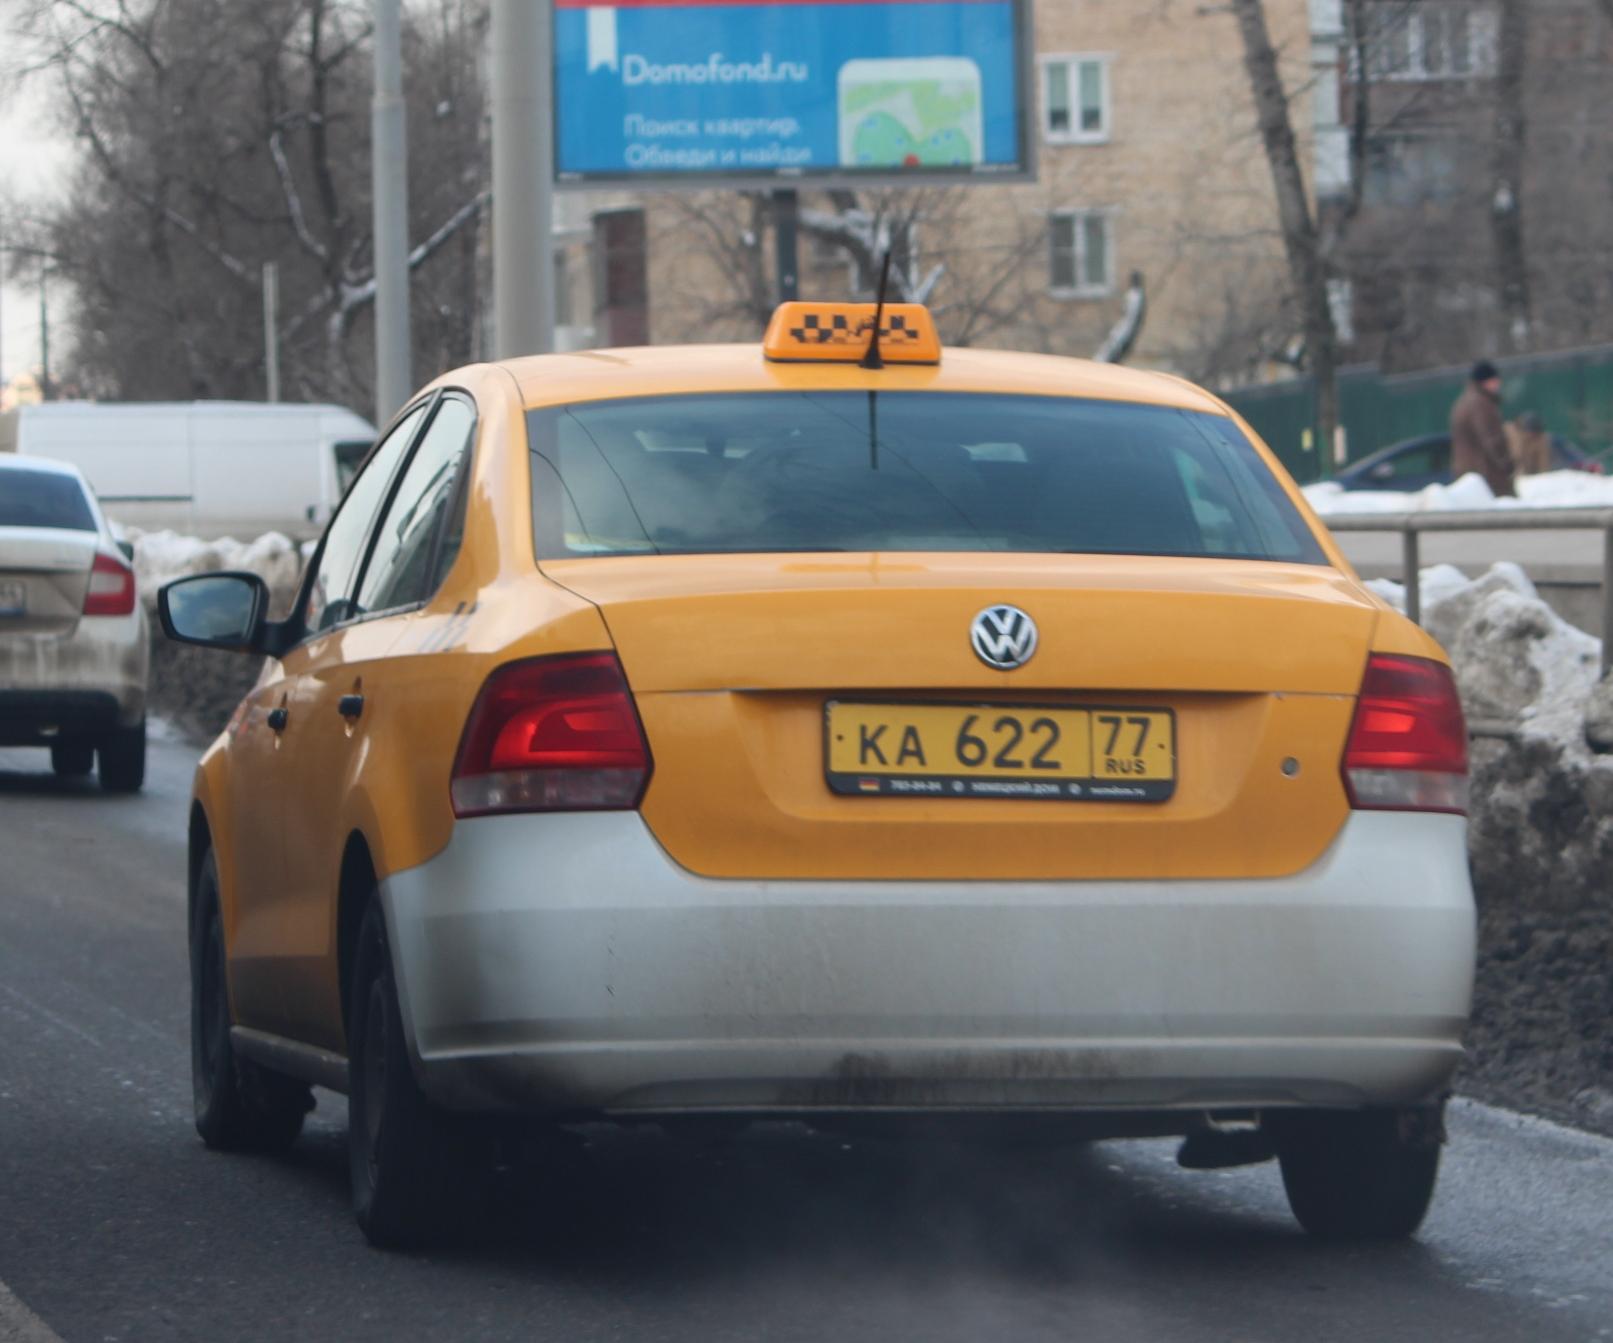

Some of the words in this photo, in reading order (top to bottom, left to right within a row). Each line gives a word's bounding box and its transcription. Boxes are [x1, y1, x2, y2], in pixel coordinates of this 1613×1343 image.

[622, 52, 808, 85] Domofond.ru
[955, 715, 1061, 769] 622
[1098, 716, 1151, 757] 77
[1105, 759, 1147, 775] RUS
